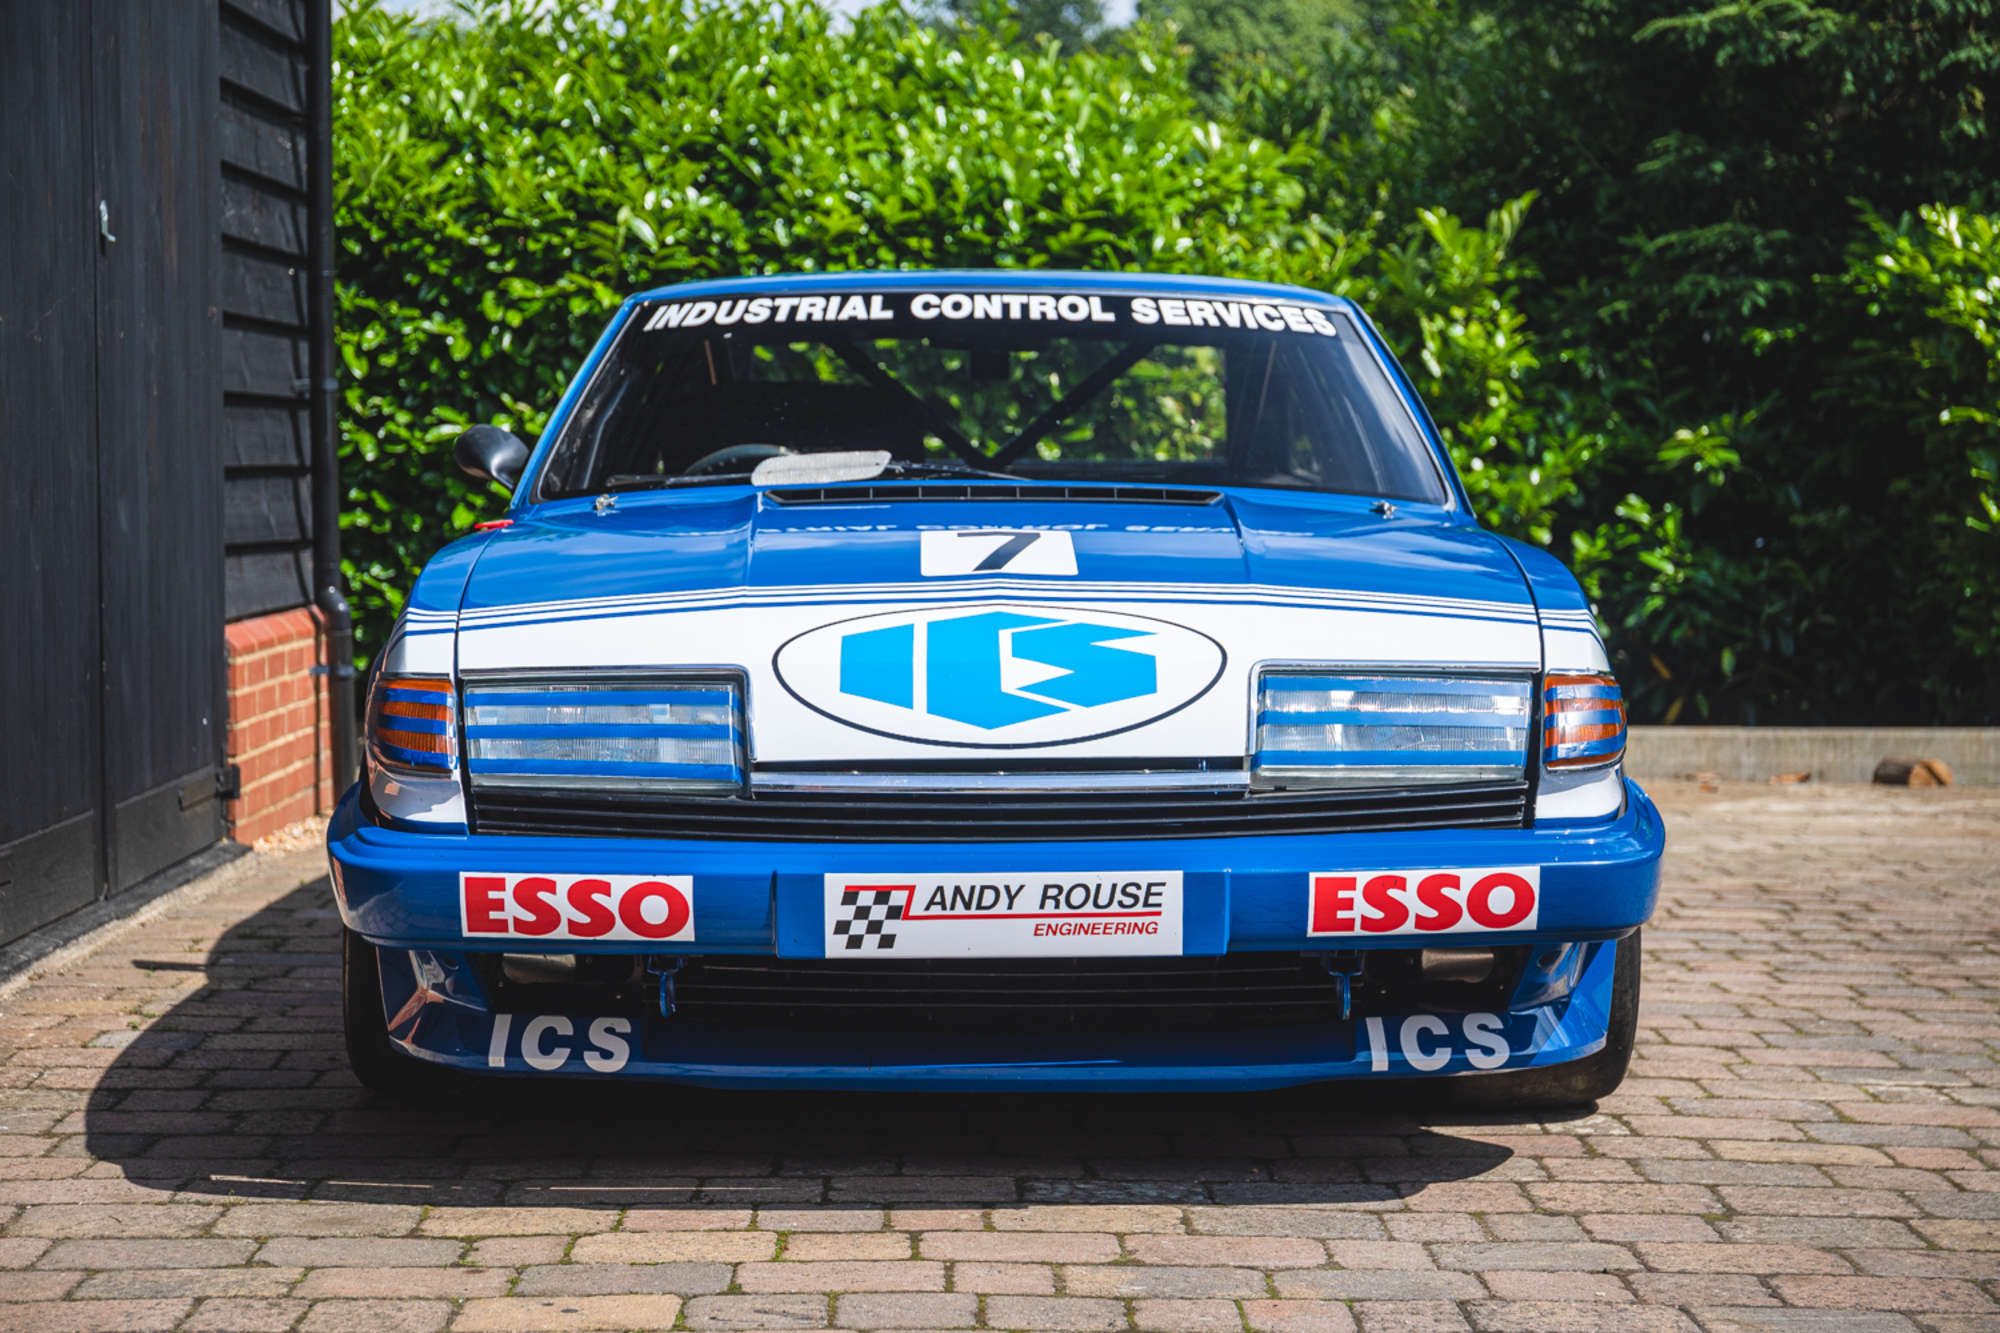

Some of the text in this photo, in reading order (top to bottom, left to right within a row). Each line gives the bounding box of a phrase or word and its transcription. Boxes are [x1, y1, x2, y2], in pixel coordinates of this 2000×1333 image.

[643, 293, 1337, 338] INDUSTRIAL CONTROL SERVICES
[957, 531, 1041, 572] 7
[464, 876, 690, 939] ESSO
[924, 881, 1167, 912] ANDY ROUSE
[1311, 872, 1536, 933] ESSO
[1033, 921, 1159, 937] ENGINEERING
[488, 1014, 632, 1073] ICS
[1365, 1012, 1511, 1073] ICS
